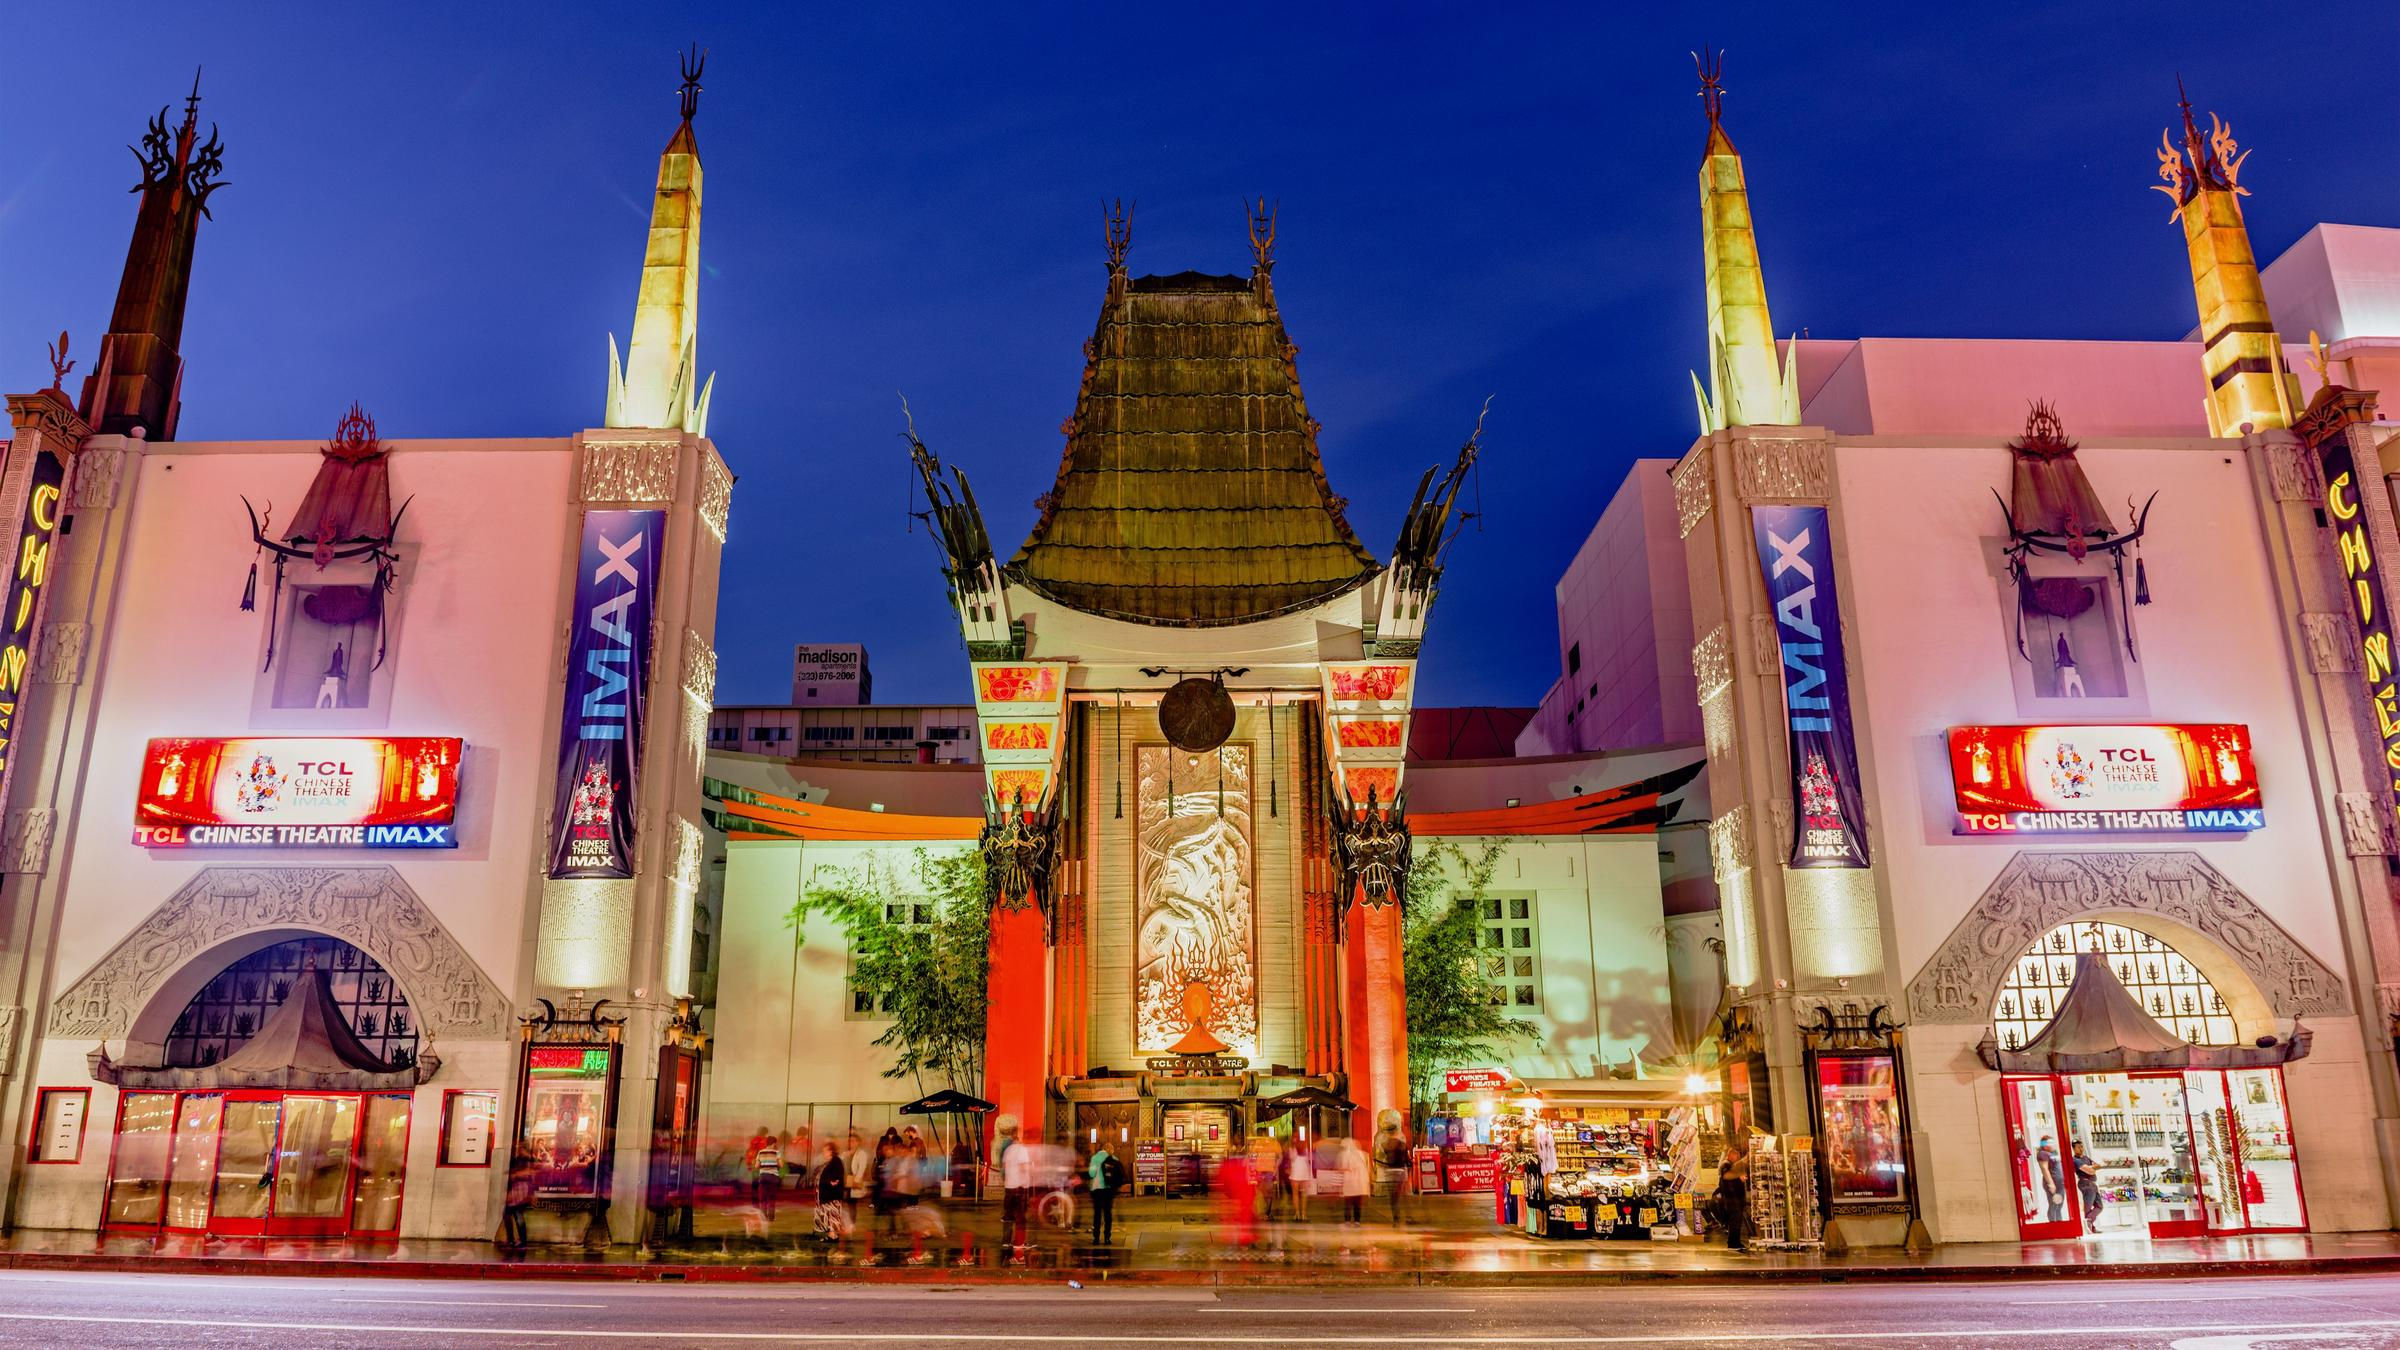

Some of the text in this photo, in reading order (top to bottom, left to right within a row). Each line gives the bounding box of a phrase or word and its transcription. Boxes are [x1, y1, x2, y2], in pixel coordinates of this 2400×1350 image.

[580, 531, 643, 740] IMAX
[1768, 527, 1832, 733] IMAX
[799, 649, 857, 663] madison
[2100, 748, 2155, 762] TCL
[297, 762, 353, 775] TCL
[2102, 764, 2158, 773] CHINESE
[294, 778, 352, 787] CHINESE
[2105, 773, 2159, 782] THEATRE
[295, 788, 351, 796] THEATRE
[293, 797, 347, 806] IMAX
[1805, 816, 1843, 829] TCL
[1963, 810, 2262, 831] TCL CHINESE THEATRE IMAX
[135, 826, 449, 845] TCL CHINESE THEATRE IMAX
[573, 825, 610, 839] TCL
[1807, 829, 1842, 837] CHINESE
[572, 839, 609, 848] CHINESE
[1808, 836, 1844, 844] THEATRE
[572, 847, 609, 855] THEATRE
[1804, 845, 1850, 857] IMAX
[567, 855, 615, 866] IMAX
[1152, 1060, 1172, 1068] TCL
